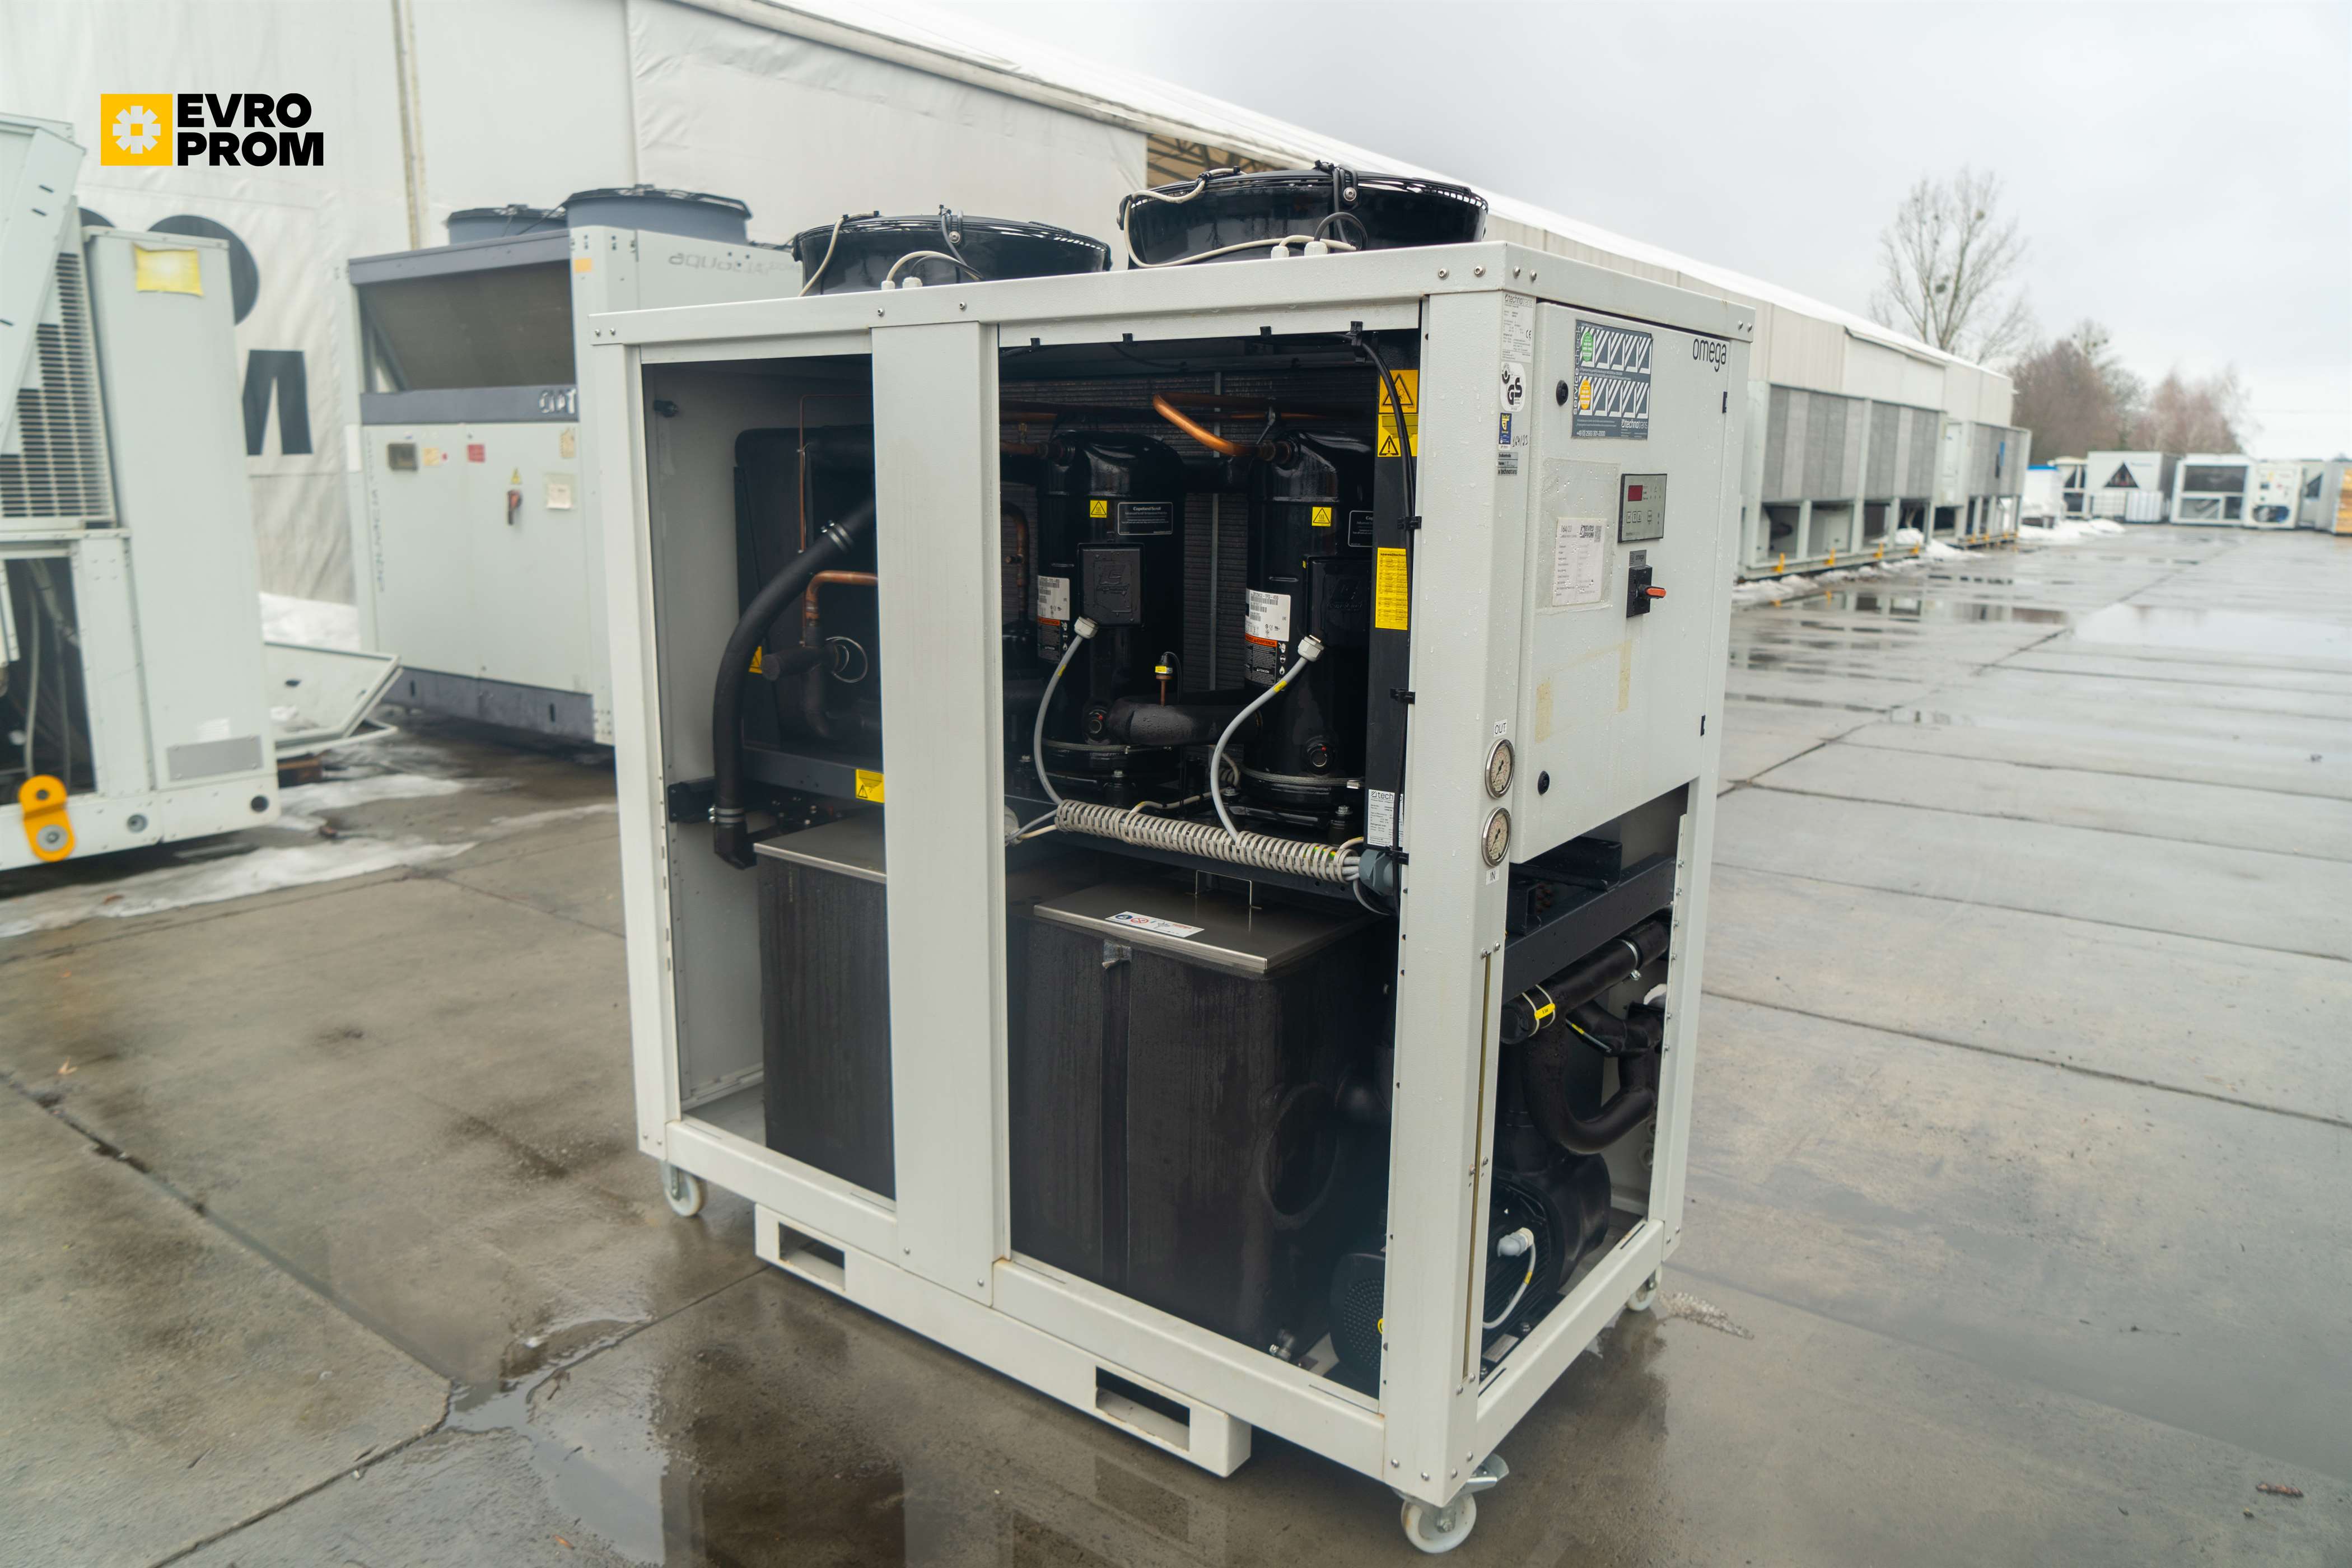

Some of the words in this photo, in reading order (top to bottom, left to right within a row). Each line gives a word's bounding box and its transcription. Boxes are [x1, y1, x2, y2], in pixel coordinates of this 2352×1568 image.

[1693, 338, 1726, 372] omega
[1495, 723, 1506, 735] OUT
[1490, 871, 1496, 881] IN
